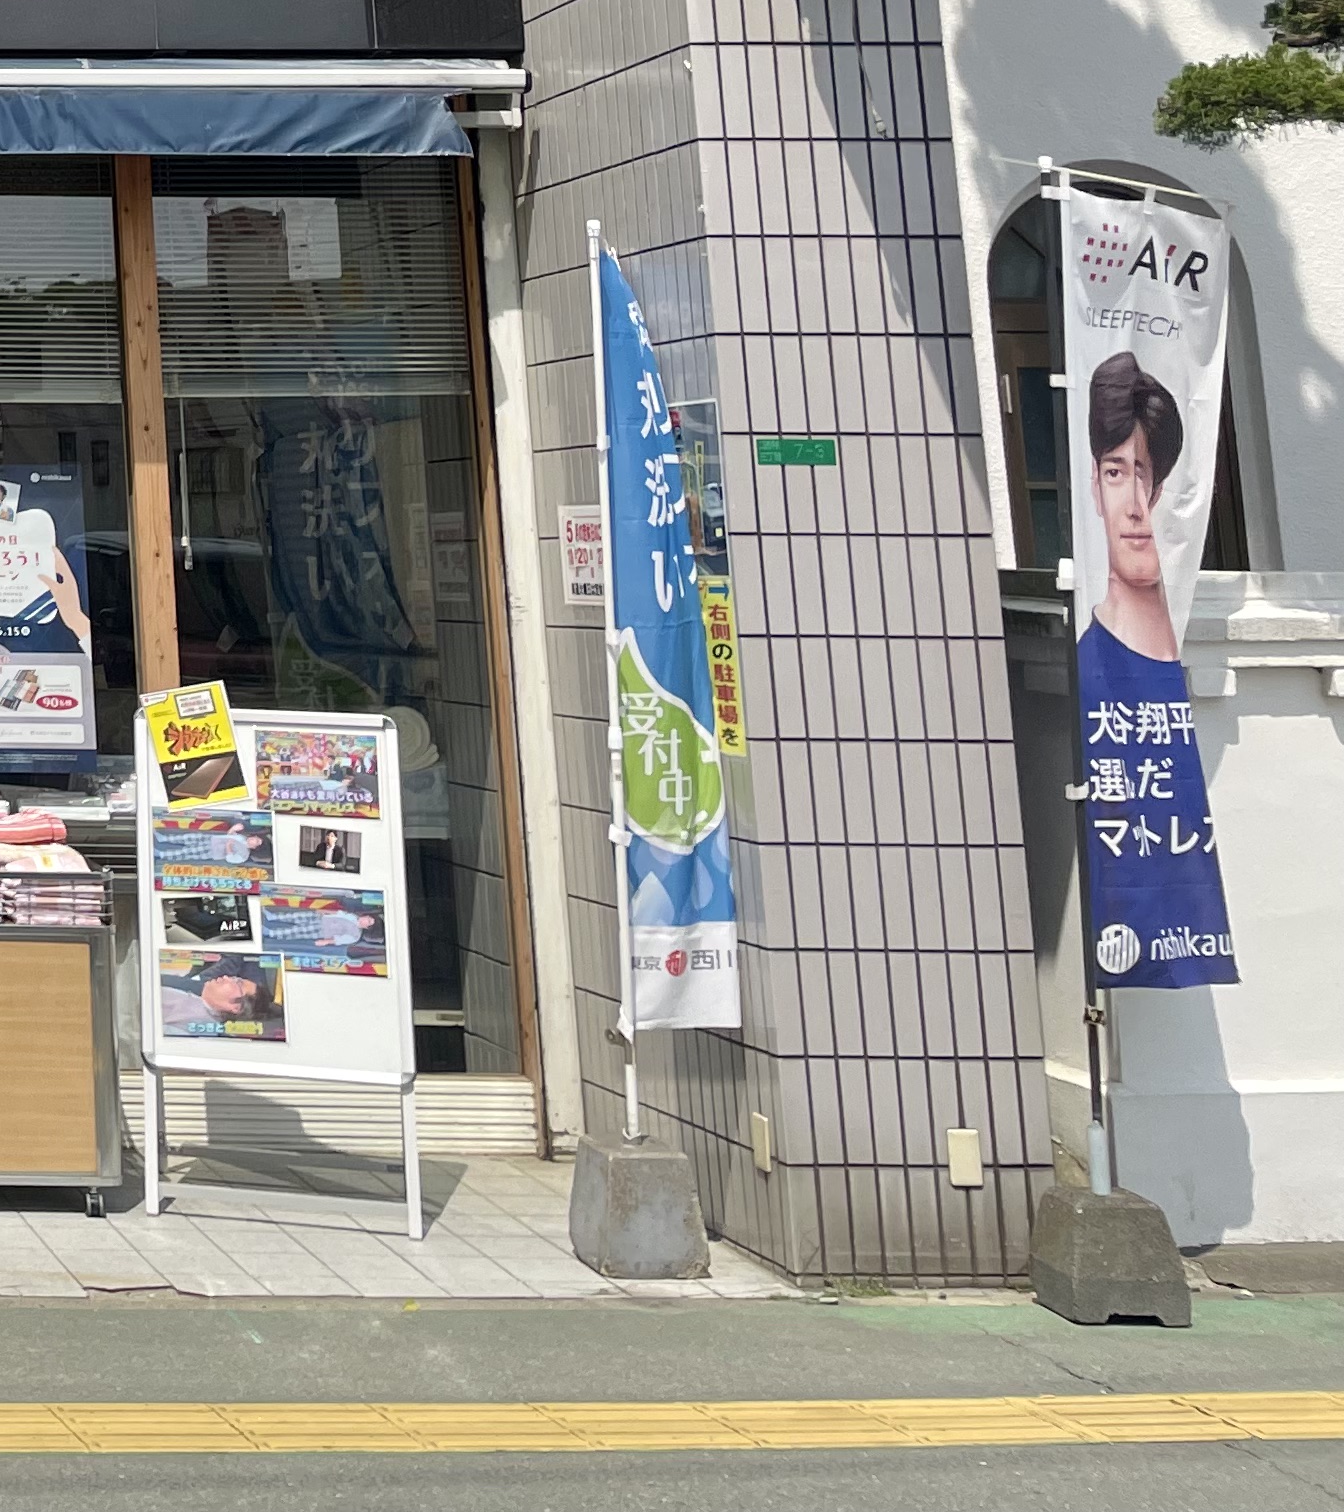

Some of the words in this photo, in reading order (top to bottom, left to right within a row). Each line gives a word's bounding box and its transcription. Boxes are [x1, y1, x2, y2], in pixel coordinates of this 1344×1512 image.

[708, 604, 739, 747] 右側の駐車場を
[1094, 814, 1216, 858] マトレ
